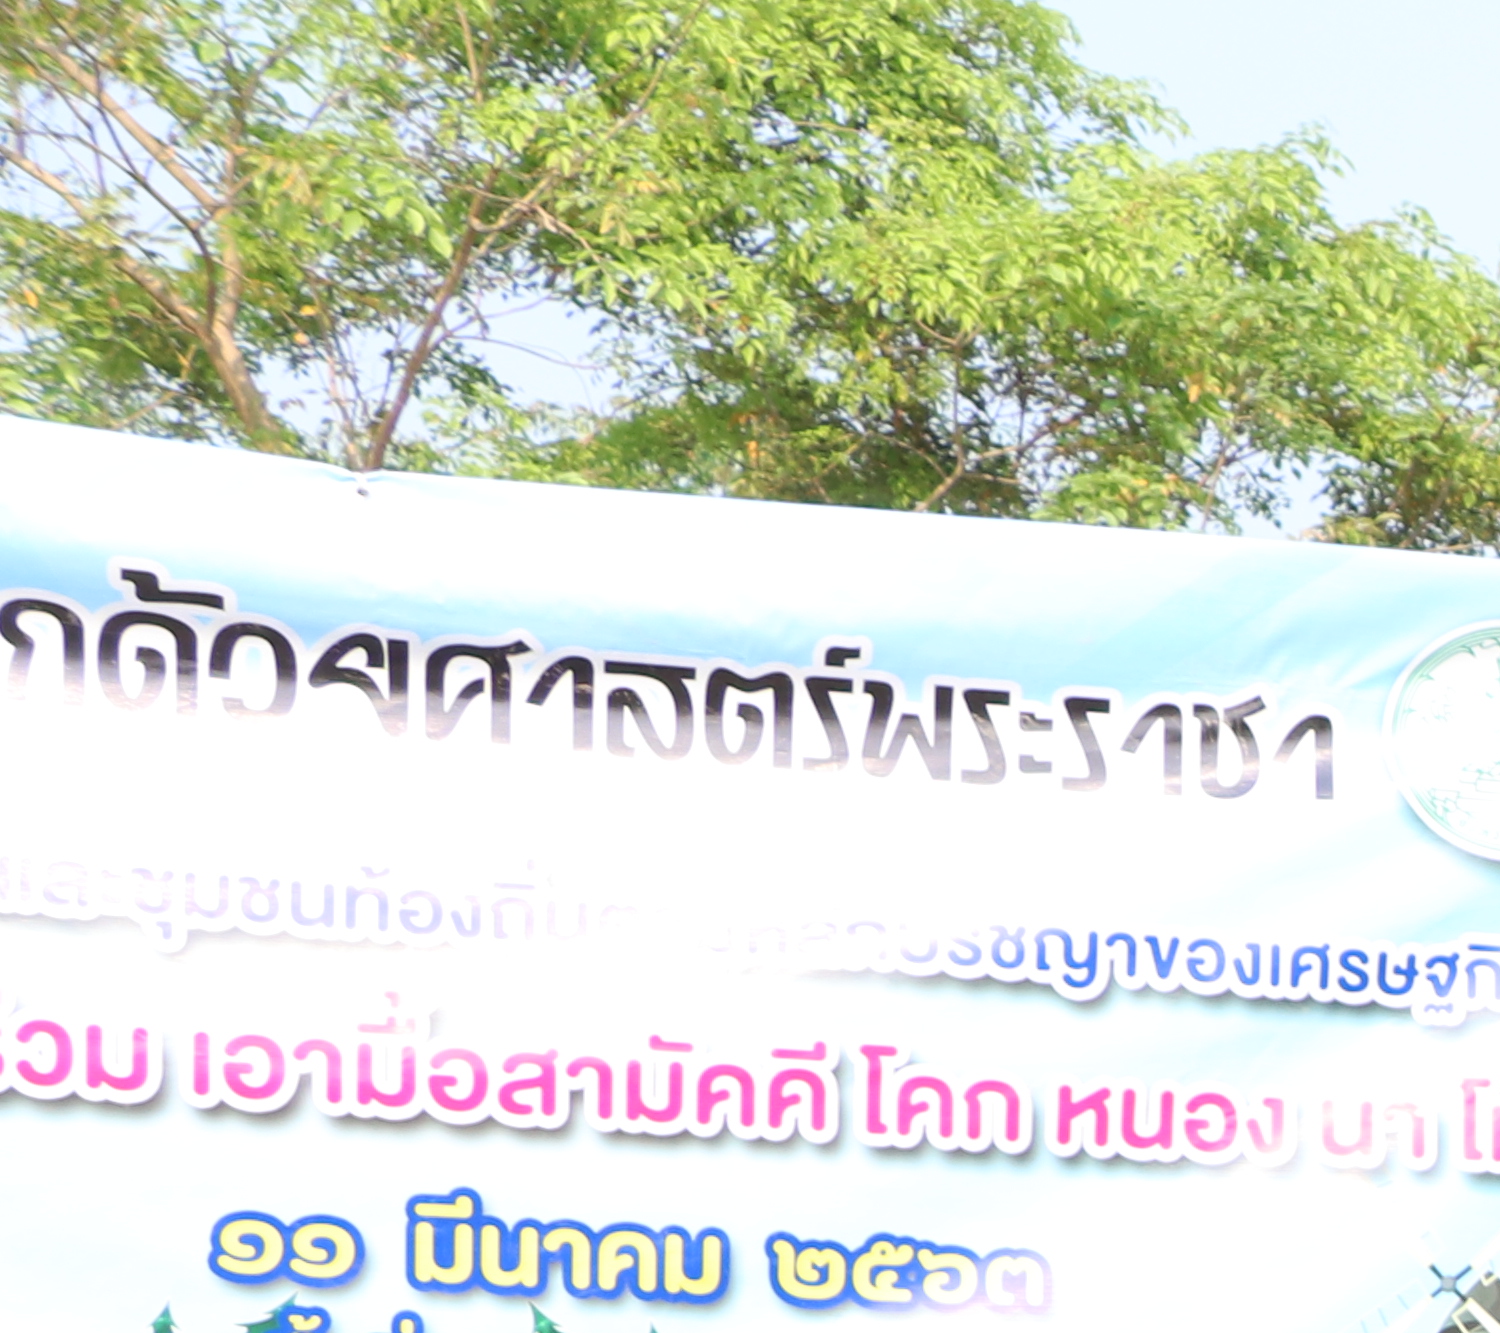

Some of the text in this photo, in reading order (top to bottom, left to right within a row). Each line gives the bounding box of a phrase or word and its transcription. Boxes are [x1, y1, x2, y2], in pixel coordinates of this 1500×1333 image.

[858, 1043, 1020, 1141] โคก
[1056, 1083, 1284, 1154] หนอง
[1321, 1099, 1426, 1159] นา
[216, 1219, 356, 1279] ๑๑
[413, 1195, 722, 1295] มีนาคม
